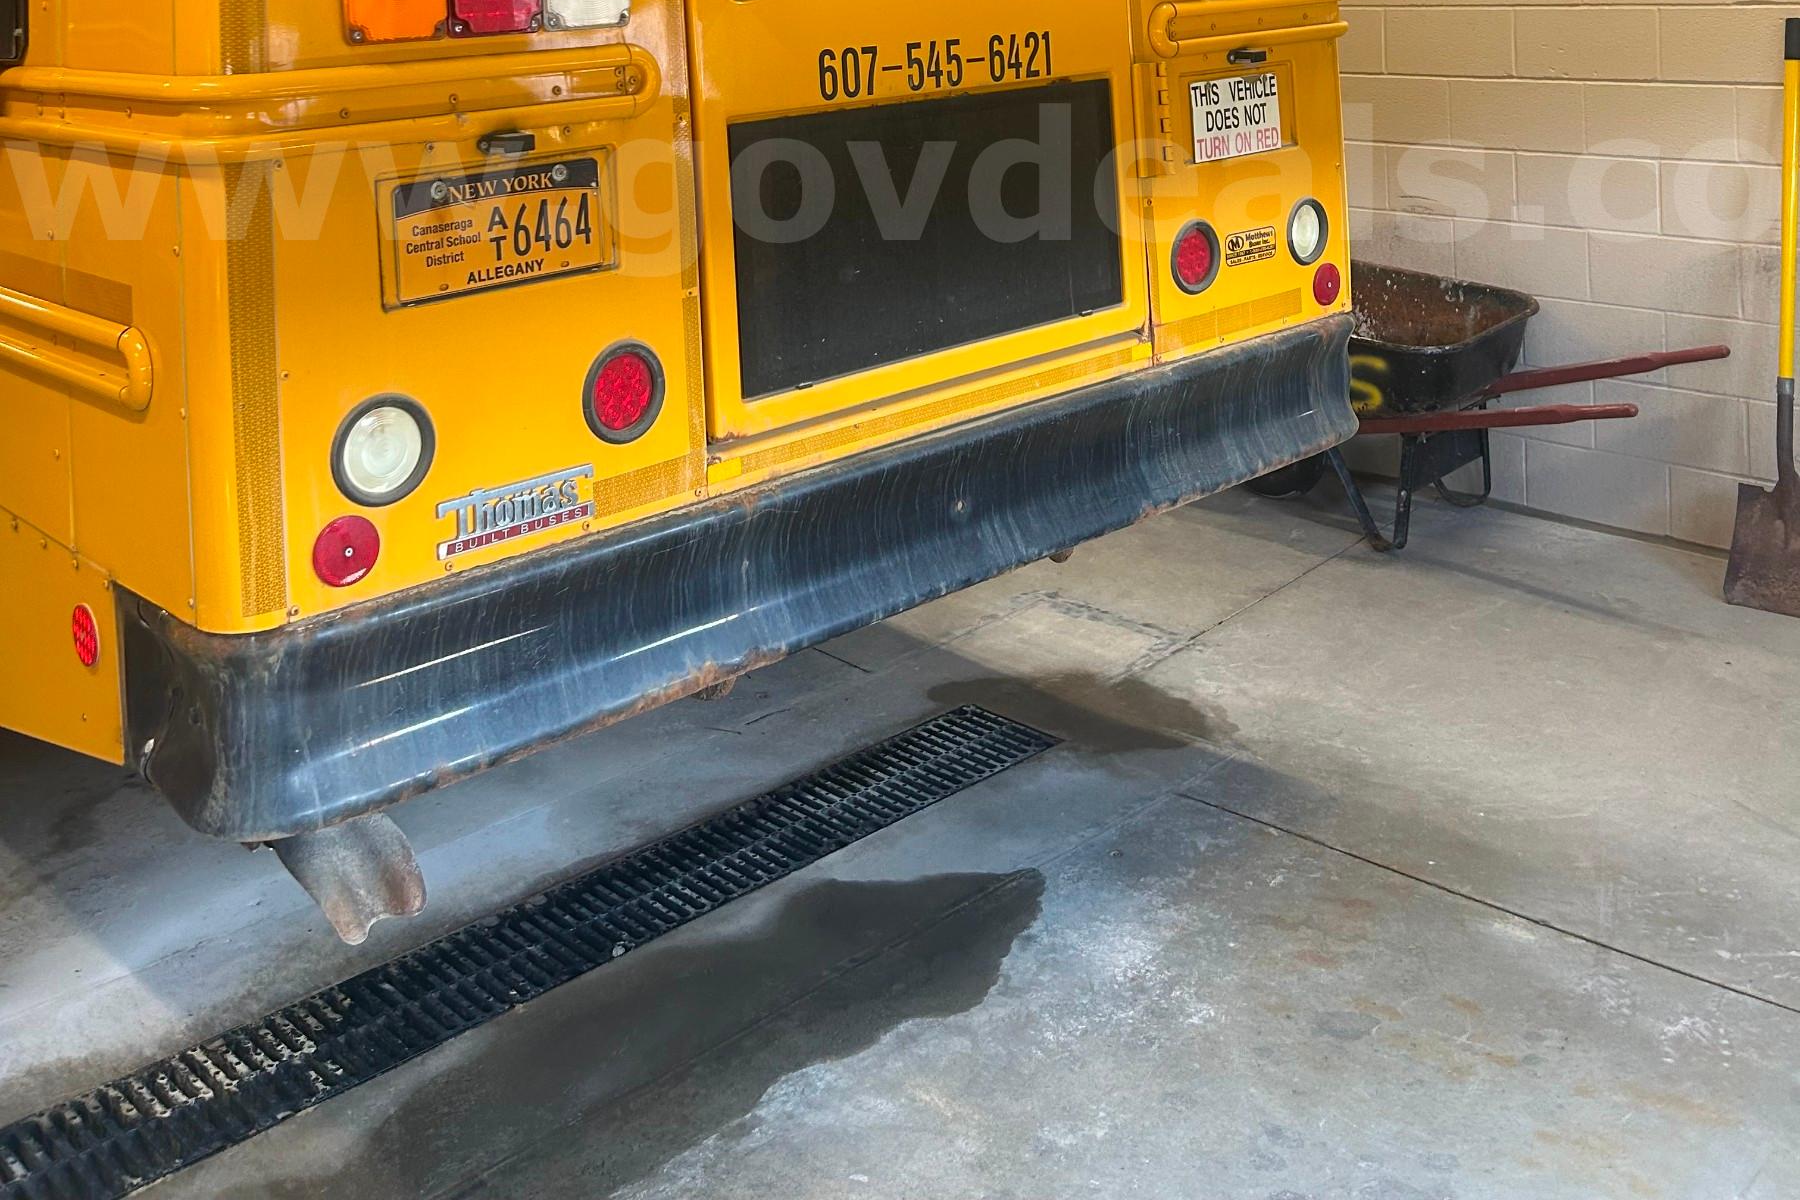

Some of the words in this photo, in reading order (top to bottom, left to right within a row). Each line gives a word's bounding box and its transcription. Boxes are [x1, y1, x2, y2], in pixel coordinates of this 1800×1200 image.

[818, 30, 1053, 101] 607-545-6421
[1191, 82, 1220, 108] THIS
[1228, 75, 1277, 102] VEHICLE
[1206, 106, 1240, 133] DOES
[1244, 102, 1267, 127] NOT
[1197, 135, 1230, 160] TURN
[1236, 131, 1252, 154] ON
[1256, 127, 1279, 151] RED
[448, 179, 498, 203] NEW
[502, 172, 553, 193] YORK
[412, 218, 473, 237] Canaseraga
[513, 192, 592, 257] 6464
[406, 238, 444, 255] Central
[446, 231, 481, 248] School
[425, 251, 465, 268] District
[466, 258, 545, 285] ALLEGANY
[436, 463, 594, 541] Thomas
[455, 528, 511, 553] BUILT
[520, 507, 583, 534] BUSES
